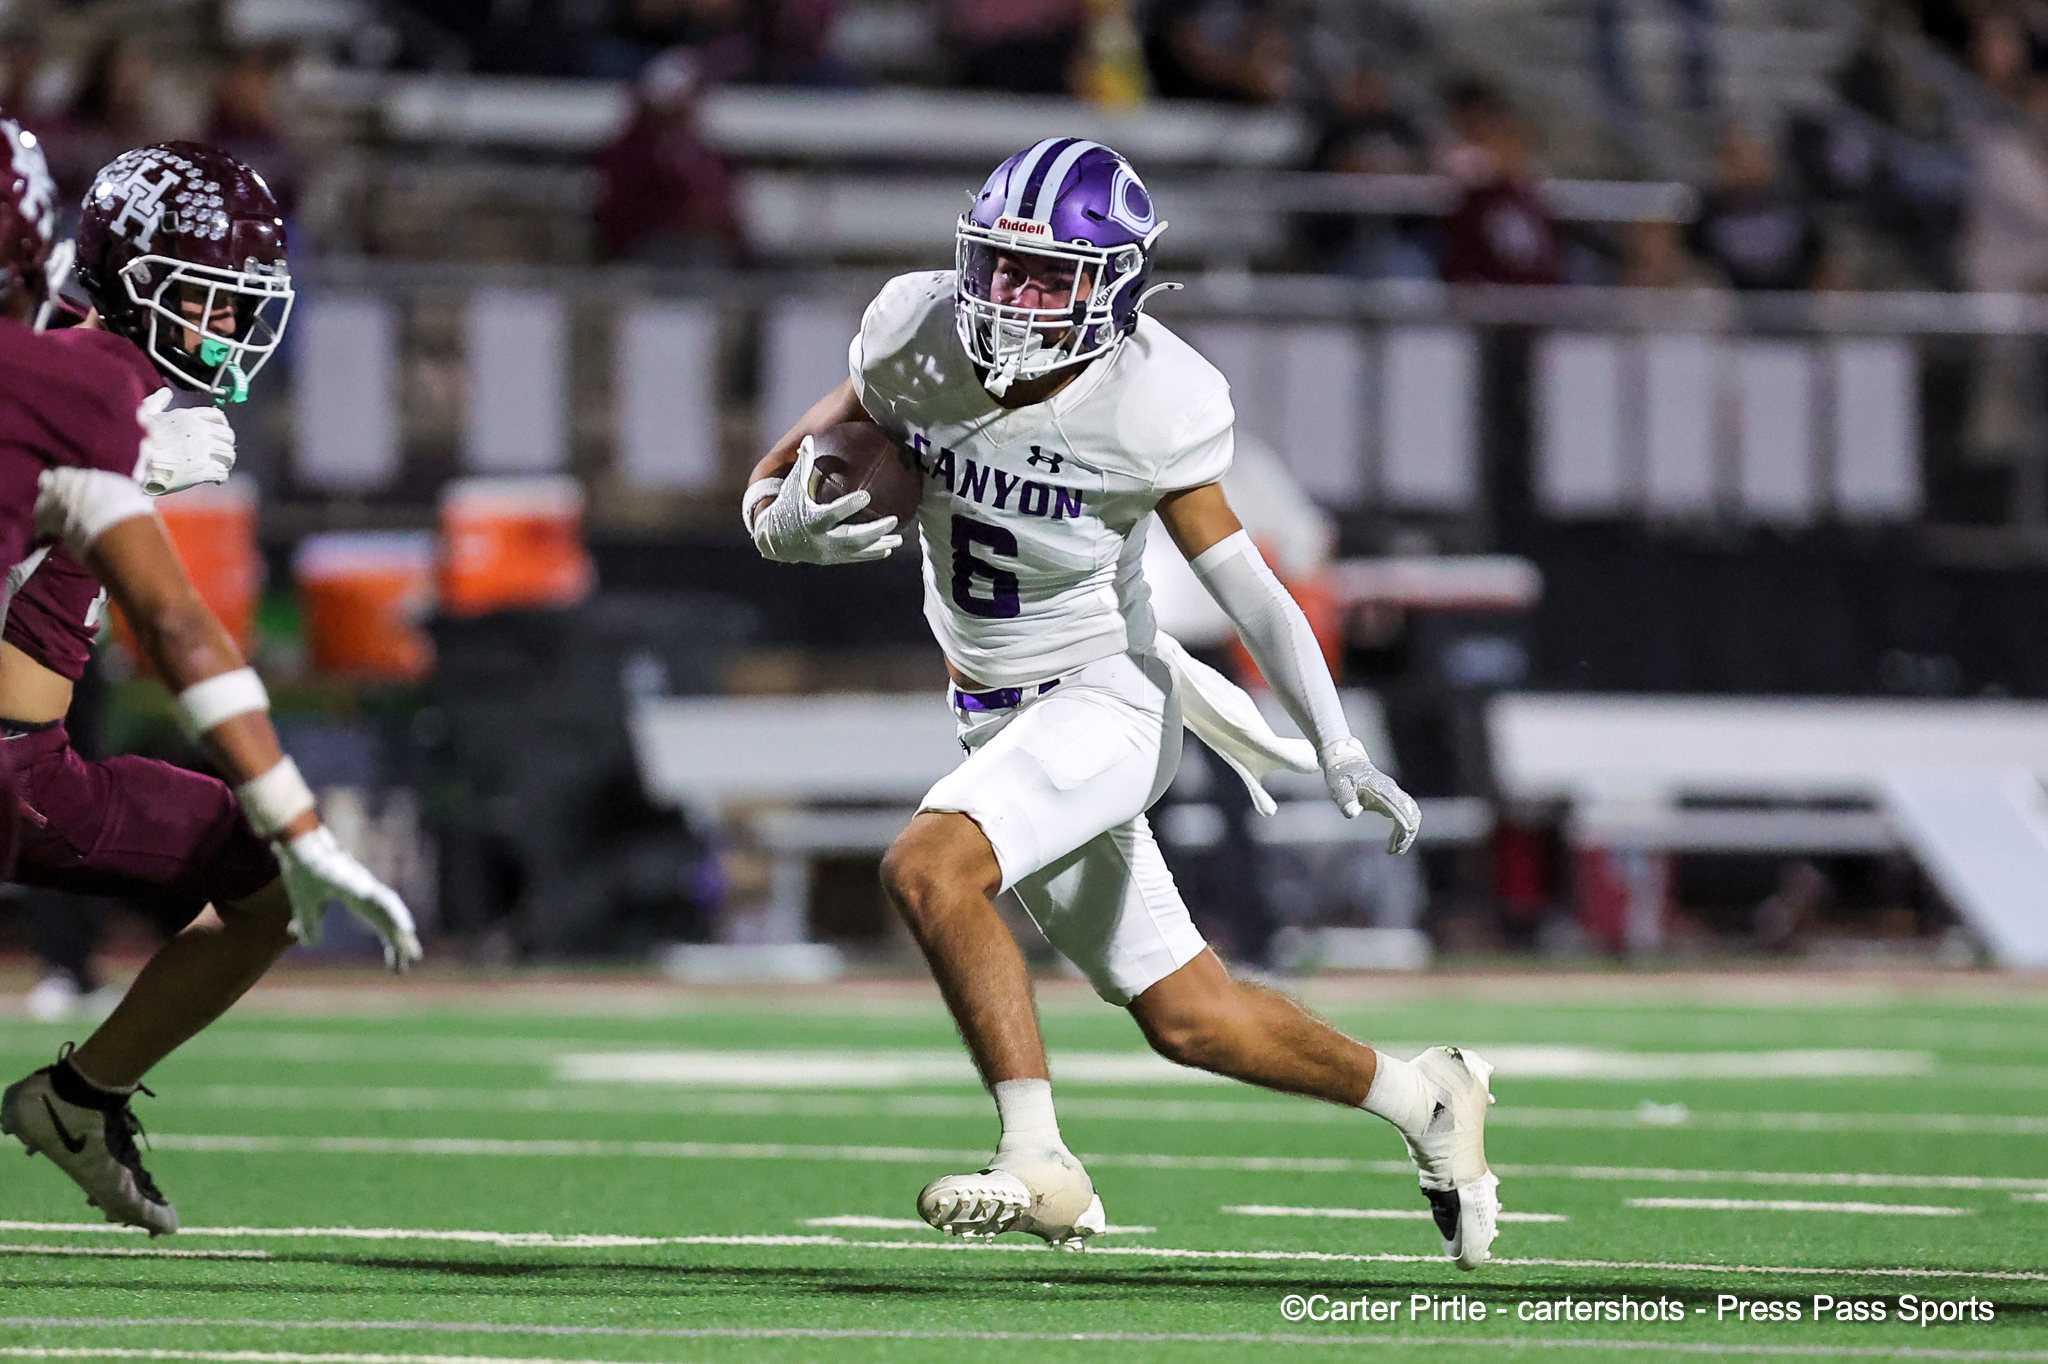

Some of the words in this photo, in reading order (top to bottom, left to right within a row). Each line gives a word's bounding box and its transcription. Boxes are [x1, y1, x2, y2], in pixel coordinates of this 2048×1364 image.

[999, 218, 1045, 235] Riddell
[913, 433, 1083, 519] CANYON
[951, 514, 1021, 619] 6
